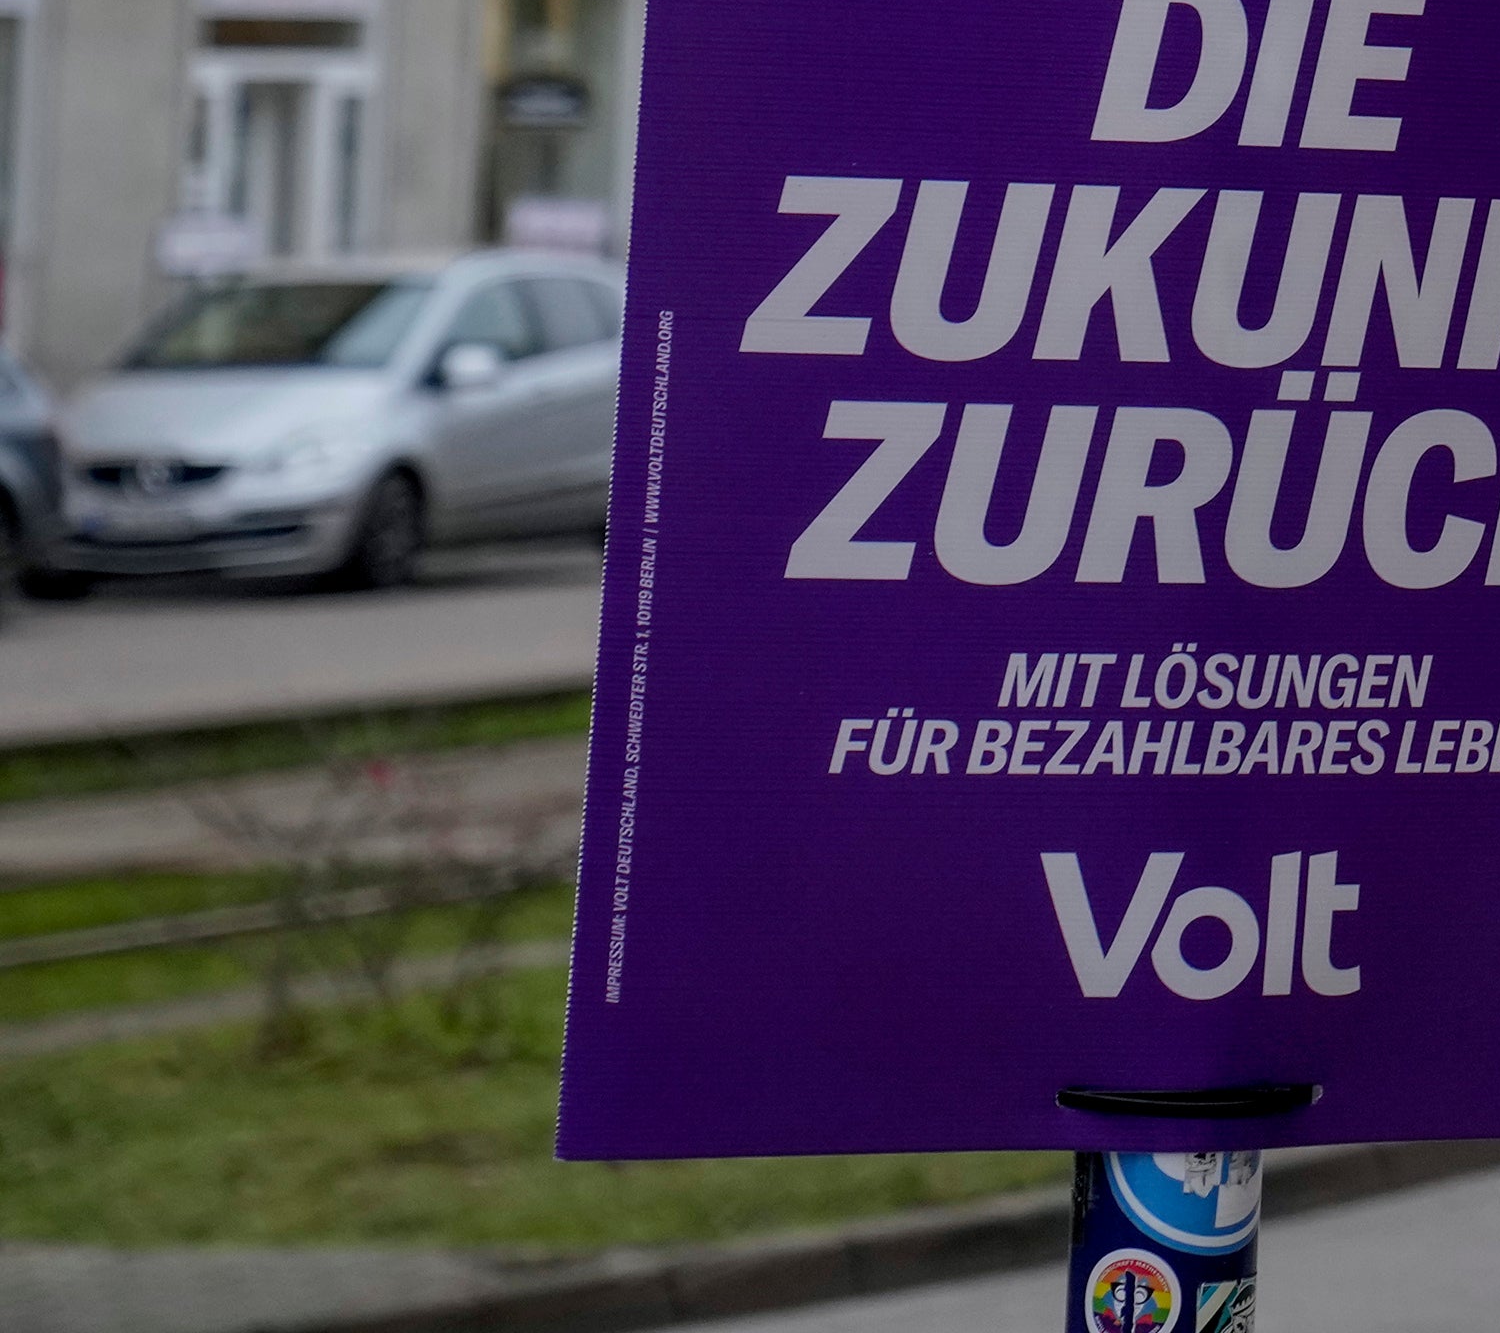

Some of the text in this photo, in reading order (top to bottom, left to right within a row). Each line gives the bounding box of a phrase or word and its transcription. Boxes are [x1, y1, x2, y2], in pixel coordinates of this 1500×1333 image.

[645, 310, 674, 523] WWW.VOLTDEUTSCHLAND.ORG
[640, 537, 656, 588] BERLIN
[637, 589, 653, 626] 10119
[632, 641, 649, 672] STR.
[998, 643, 1434, 710] MIT LÖSUNGEN
[625, 674, 646, 762] SCHWEDTER
[828, 708, 959, 775] FÜR
[965, 719, 1391, 776] BEZAHLBARES
[617, 764, 639, 874] DEUTSCHLAND,
[614, 875, 630, 911] VOLT
[1039, 850, 1361, 1001] Volt
[607, 914, 627, 1003] IMPRESSUM:
